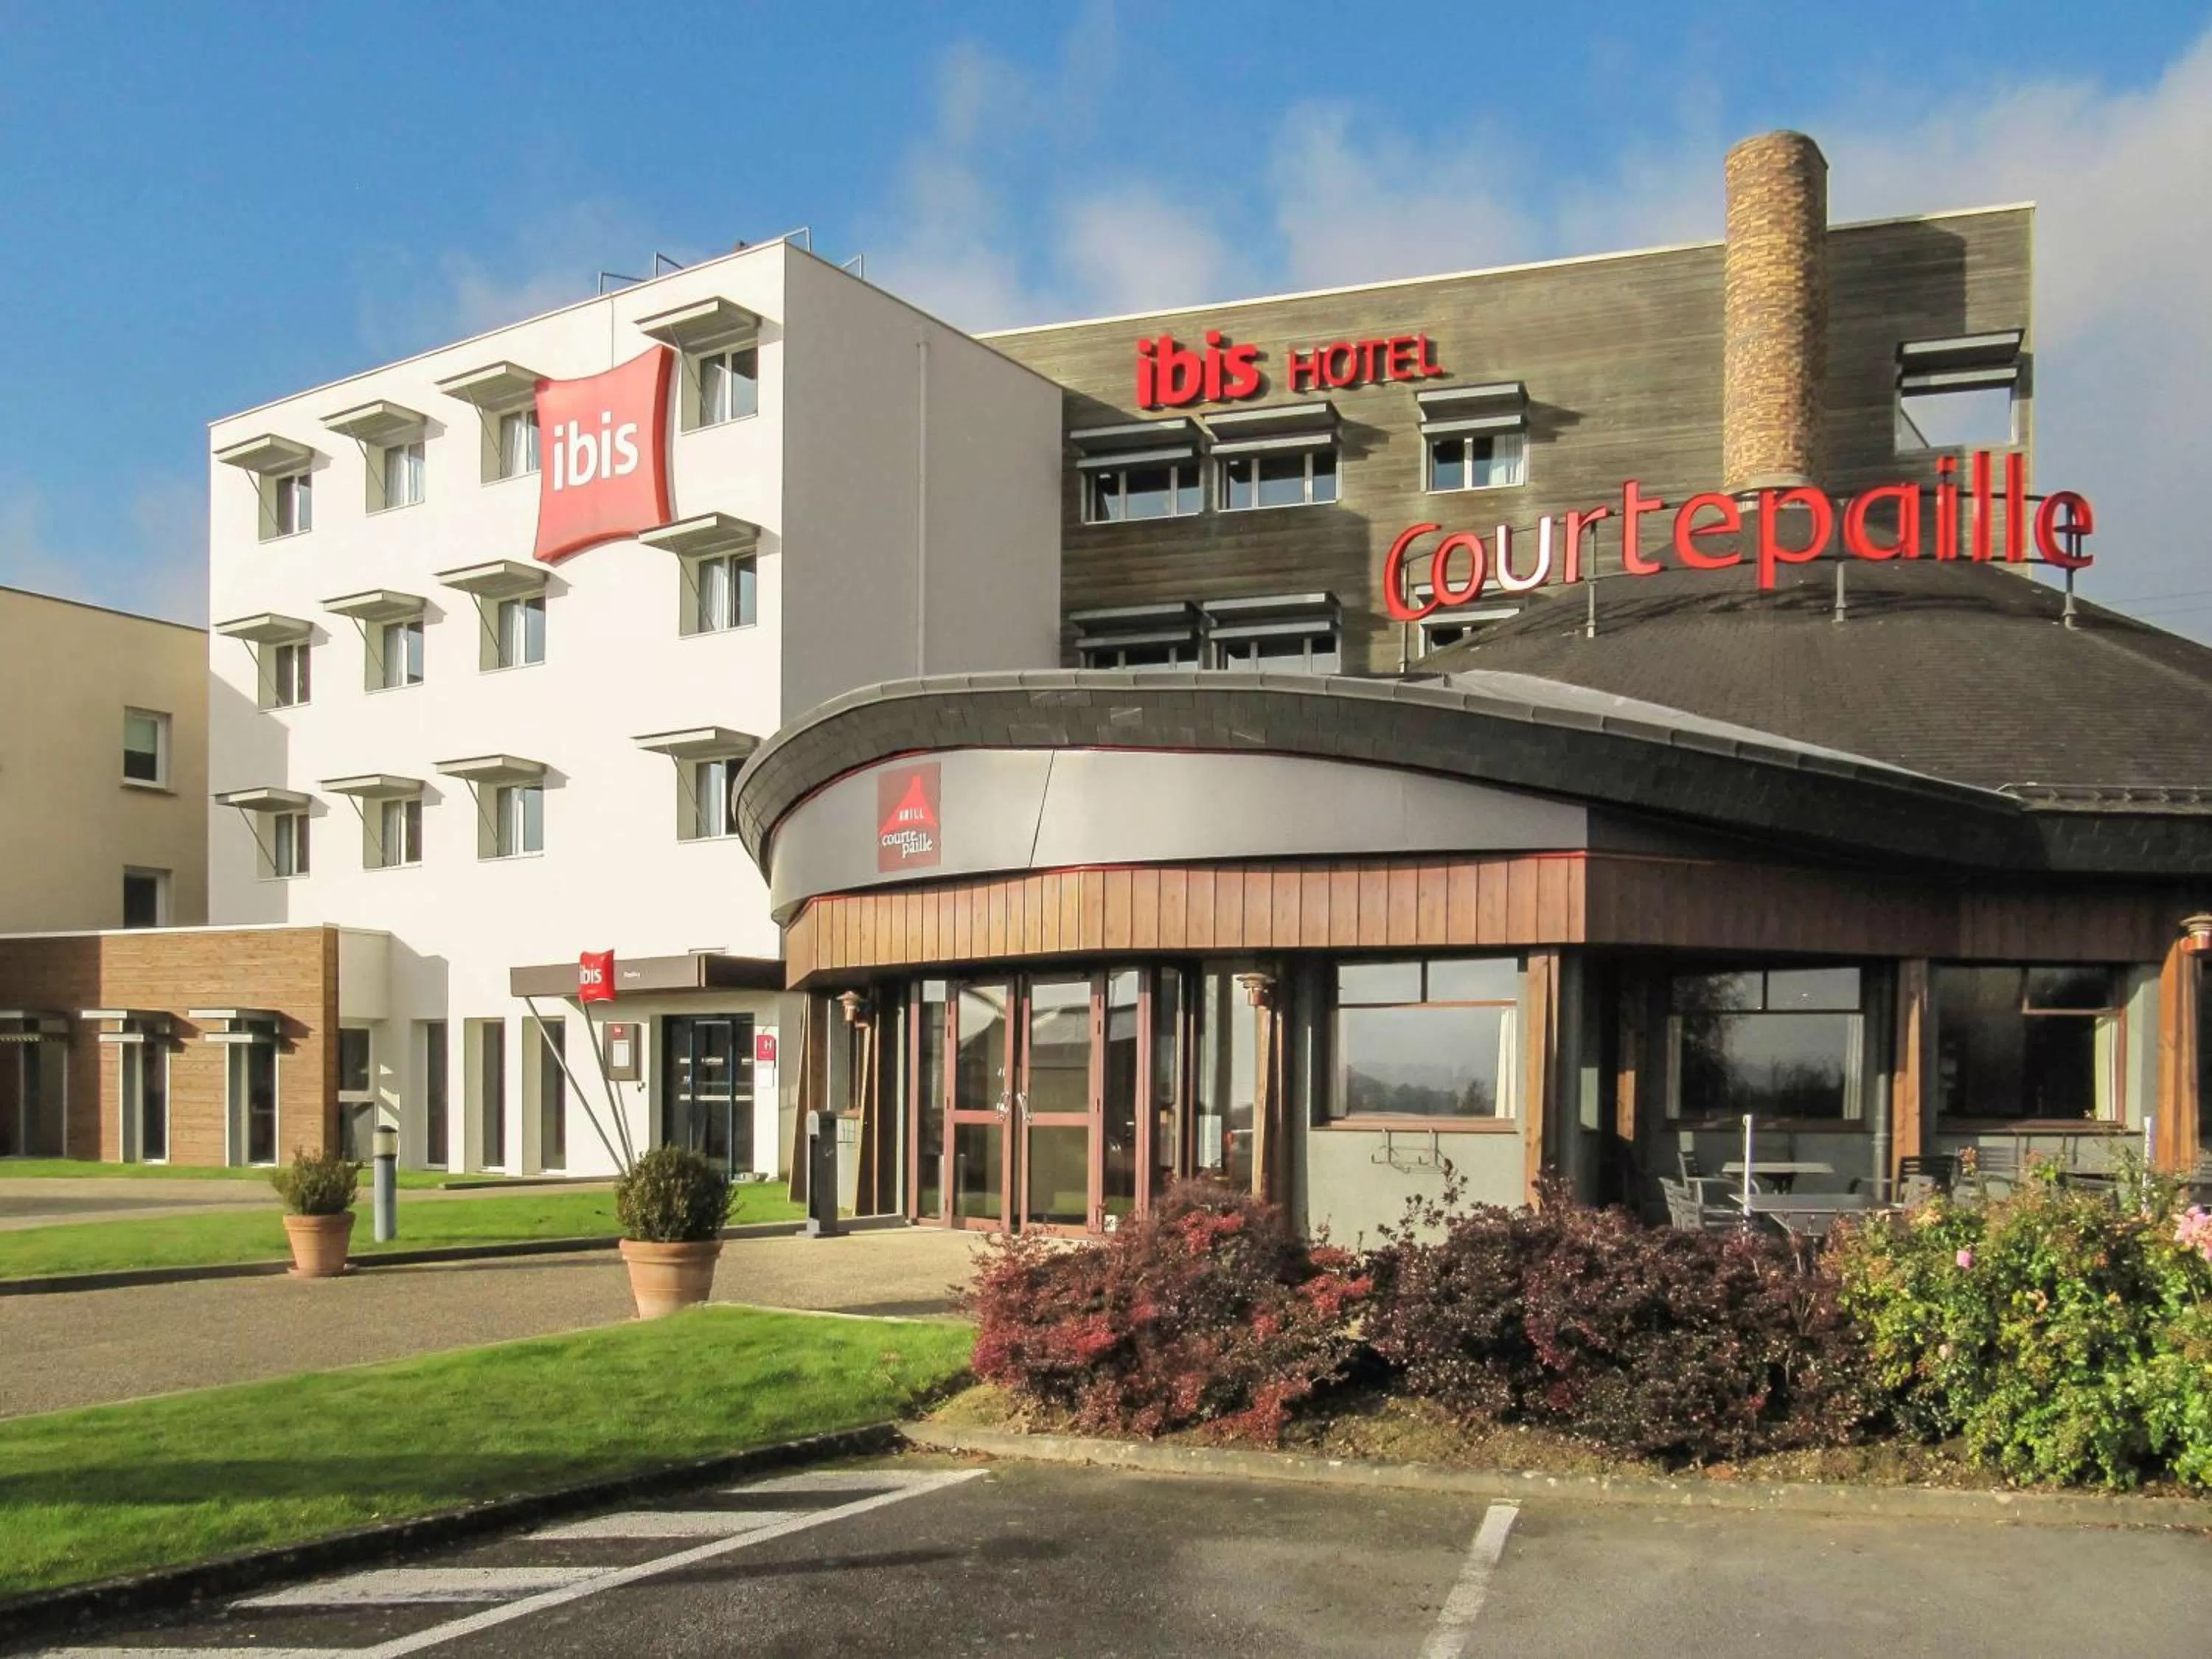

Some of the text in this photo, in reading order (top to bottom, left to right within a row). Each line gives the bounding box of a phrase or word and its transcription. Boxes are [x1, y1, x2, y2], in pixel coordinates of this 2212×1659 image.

[1136, 330, 1443, 409] ibis HOTEL
[554, 411, 639, 491] ibis
[881, 830, 917, 846] courte
[902, 832, 933, 859] paille
